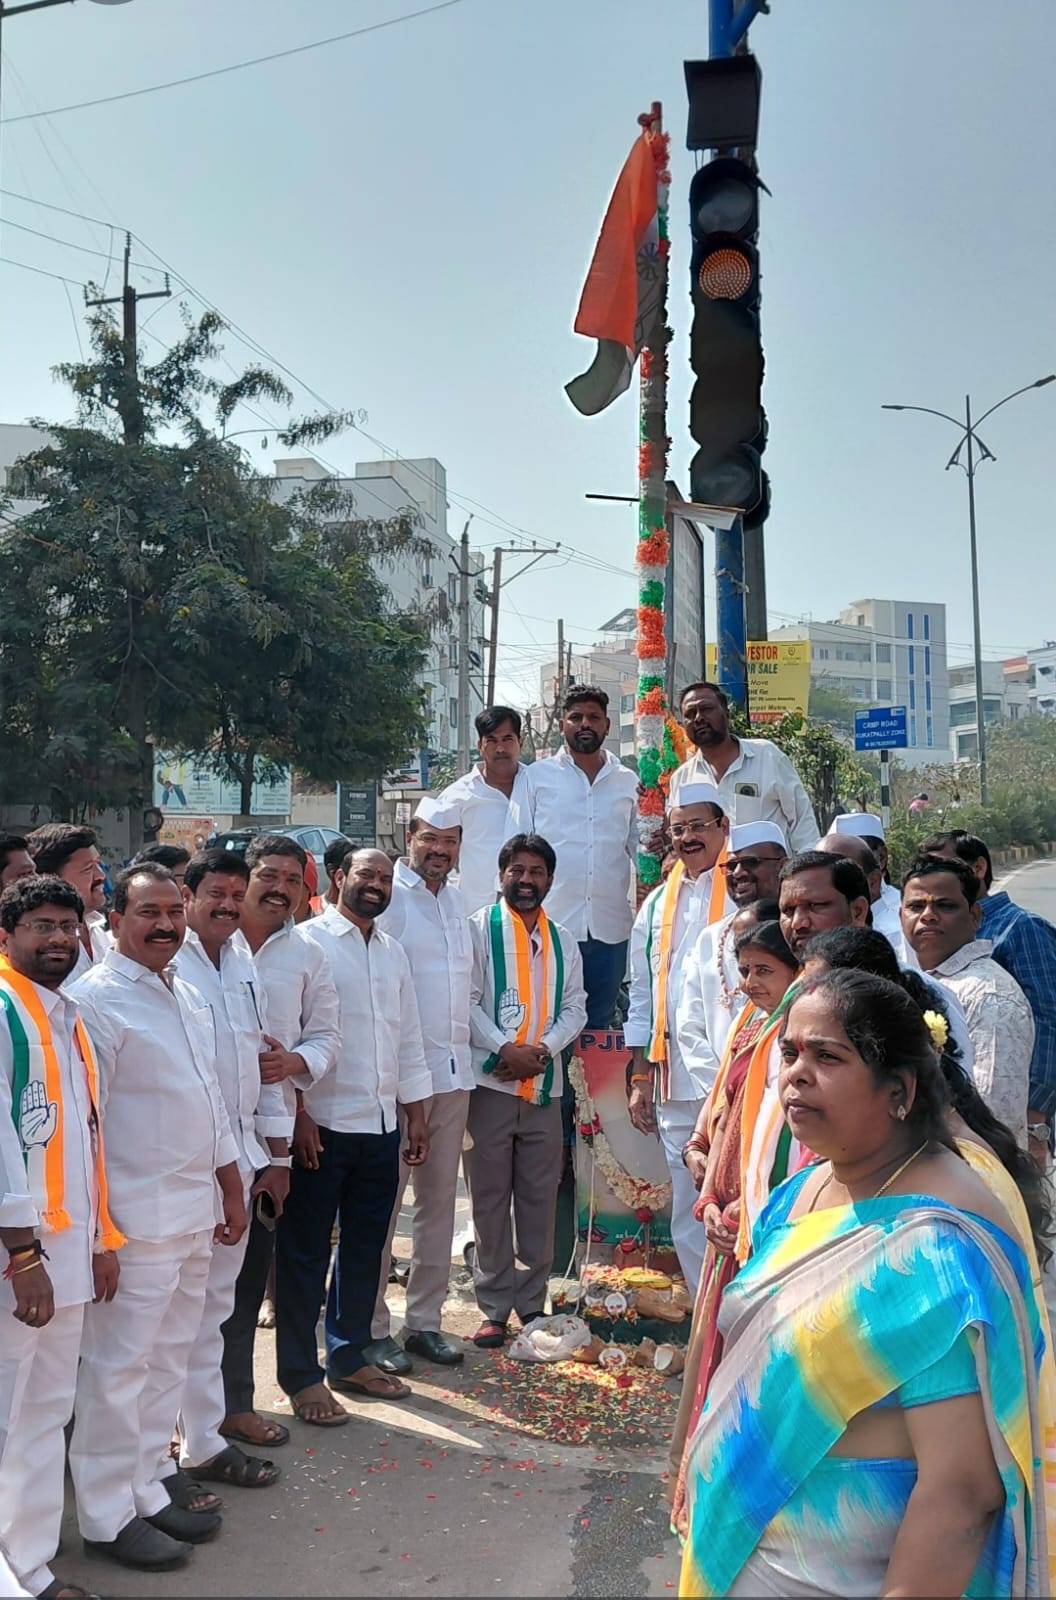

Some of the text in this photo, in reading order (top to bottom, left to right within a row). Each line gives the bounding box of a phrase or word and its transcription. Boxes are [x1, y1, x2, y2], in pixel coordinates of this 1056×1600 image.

[747, 646, 778, 660] VESTOR
[759, 664, 778, 674] SALE
[863, 721, 880, 729] CAMP
